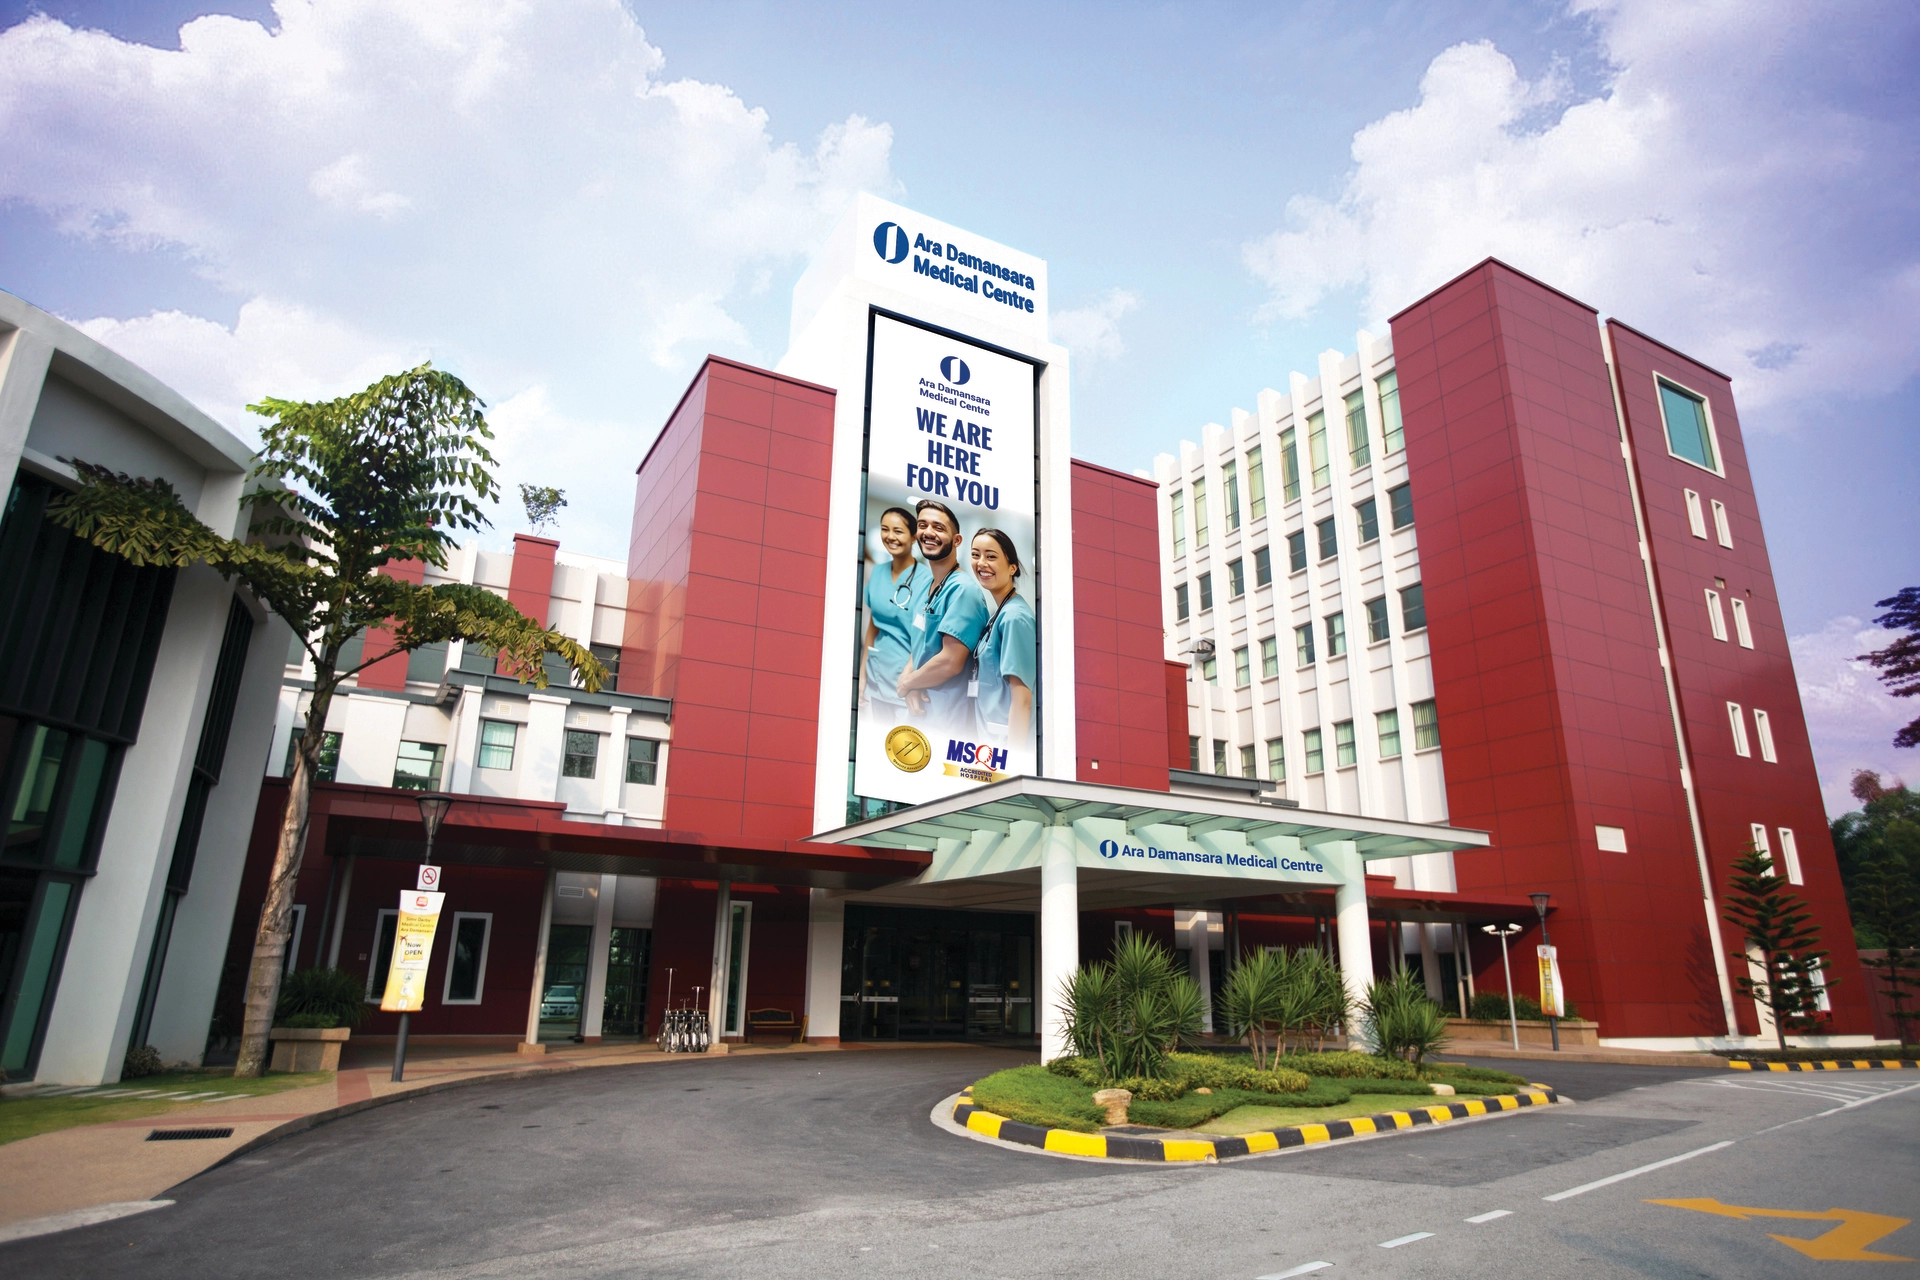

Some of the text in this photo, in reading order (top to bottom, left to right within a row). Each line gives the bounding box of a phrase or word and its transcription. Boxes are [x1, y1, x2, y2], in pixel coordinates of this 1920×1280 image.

[913, 232, 1036, 291] Ara Damansara
[913, 255, 1035, 313] Medical Centre
[918, 377, 991, 406] Ara Damansara
[919, 388, 990, 416] Medical Centre
[916, 406, 993, 451] WE ARE
[927, 439, 981, 476] HERE
[906, 462, 1000, 511] FOR YOU
[946, 739, 1008, 772] MSQH
[960, 767, 993, 778] ACCREDITED
[960, 772, 993, 783] HOSPITAL
[1121, 844, 1324, 873] Ara Damansara Medical Centre
